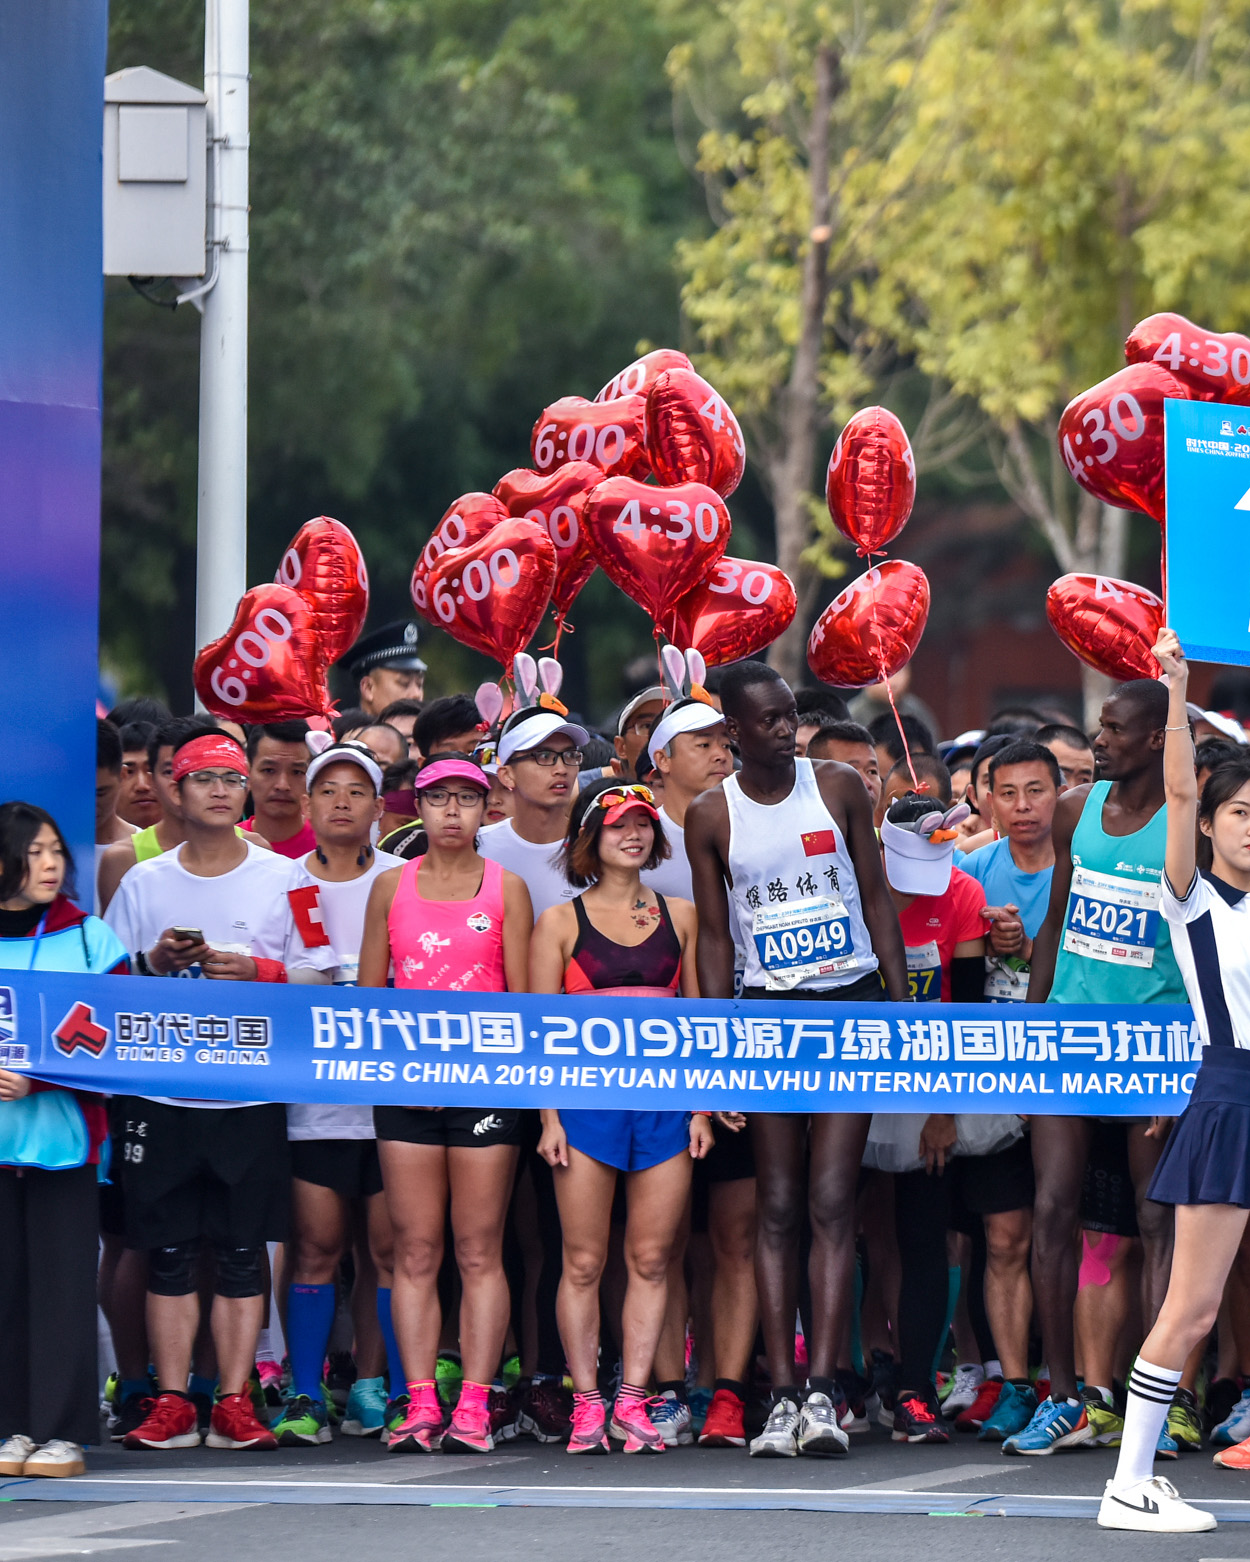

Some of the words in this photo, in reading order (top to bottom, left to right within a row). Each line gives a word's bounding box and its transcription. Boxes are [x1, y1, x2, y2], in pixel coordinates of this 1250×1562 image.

[534, 423, 626, 469] 6:00
[1062, 391, 1146, 484] 4:30
[612, 499, 720, 543] 4:30
[433, 548, 520, 623] 6:00
[210, 608, 292, 706] 6:00
[1071, 898, 1148, 939] A2021
[764, 921, 846, 963] A0949
[115, 1013, 271, 1048] 时代中国
[116, 1047, 185, 1064] TIMES
[196, 1050, 271, 1067] CHINA
[312, 1059, 397, 1083] TIMES
[402, 1061, 490, 1086] CHINA
[495, 1064, 553, 1087] 2019
[560, 1066, 677, 1089] HEYUAN
[684, 1069, 821, 1092] WANLVHU
[829, 1071, 1055, 1095] INTERNATIONAL
[1061, 1072, 1198, 1095] MARATHO
